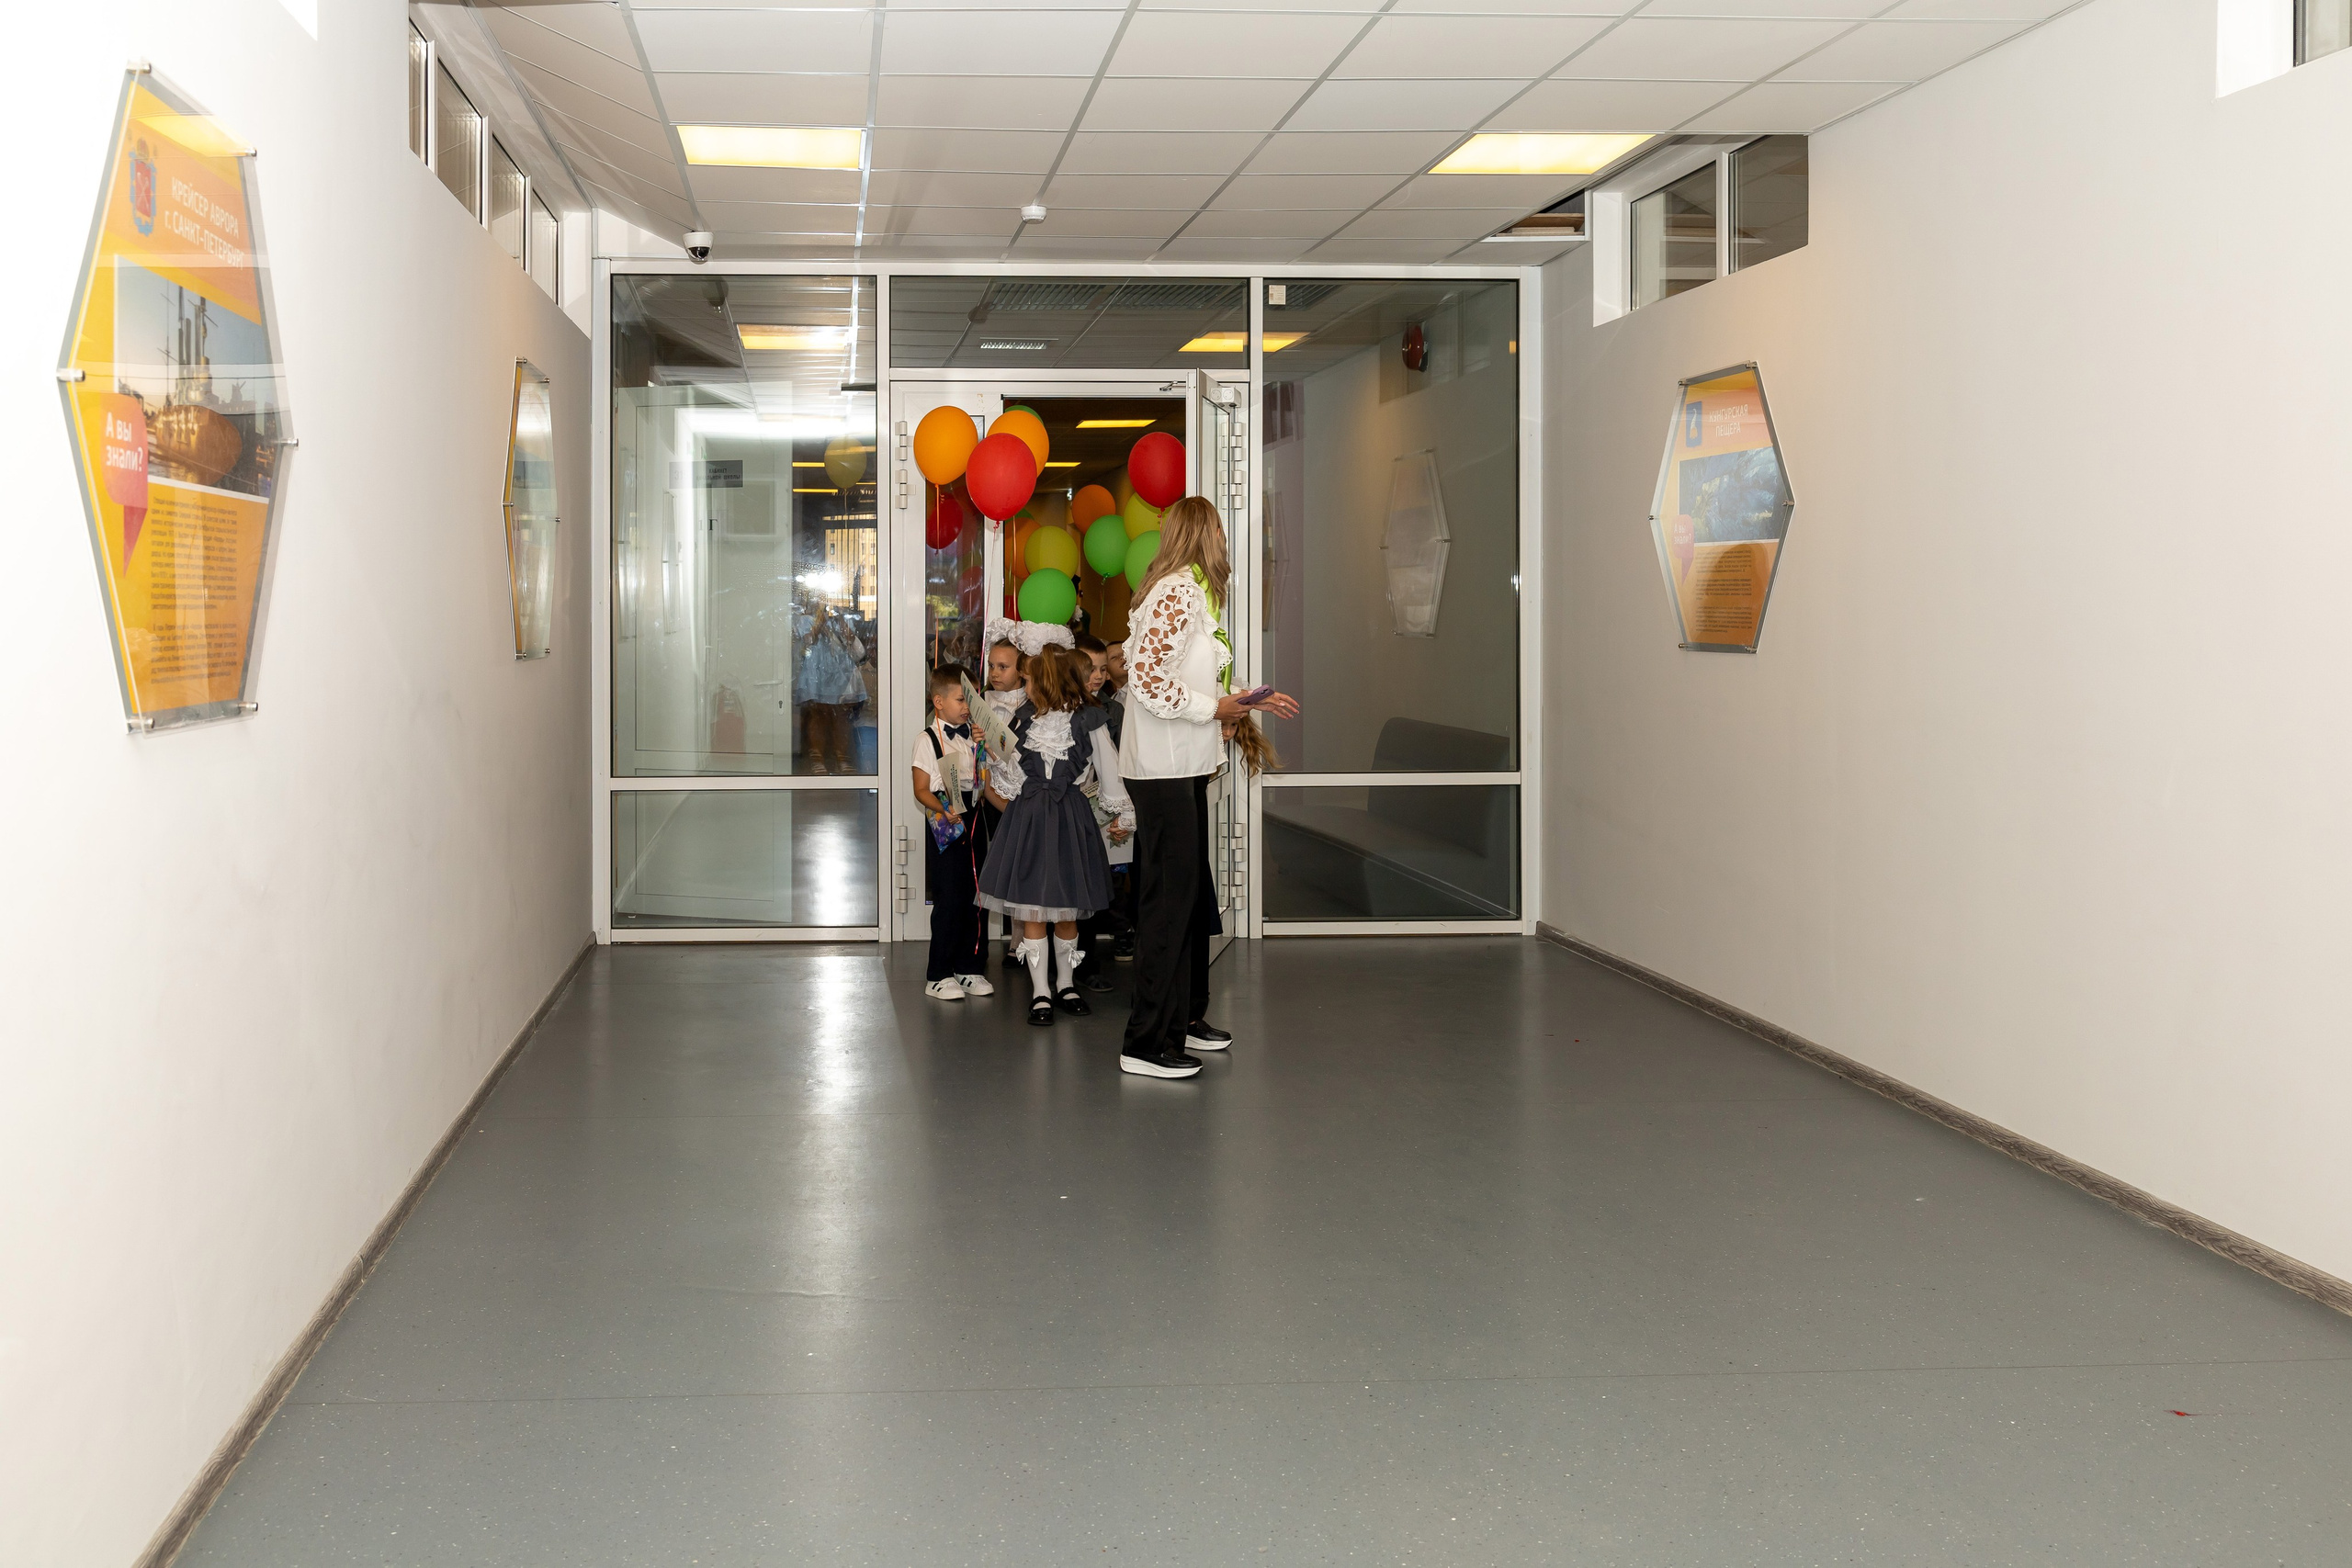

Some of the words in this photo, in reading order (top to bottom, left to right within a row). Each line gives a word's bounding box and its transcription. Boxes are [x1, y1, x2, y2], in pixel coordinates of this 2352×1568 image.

[171, 176, 209, 218] КРЕЙСЕР
[209, 202, 239, 239] АВРОРА
[173, 210, 244, 270] САНКТ-ПЕТЕРБУРГ
[106, 412, 114, 439] А
[116, 419, 132, 443] вы
[1709, 403, 1748, 423] КУНГУРСКАЯ
[1715, 422, 1741, 437] ПЕЩЕРА
[106, 445, 143, 472] знали?
